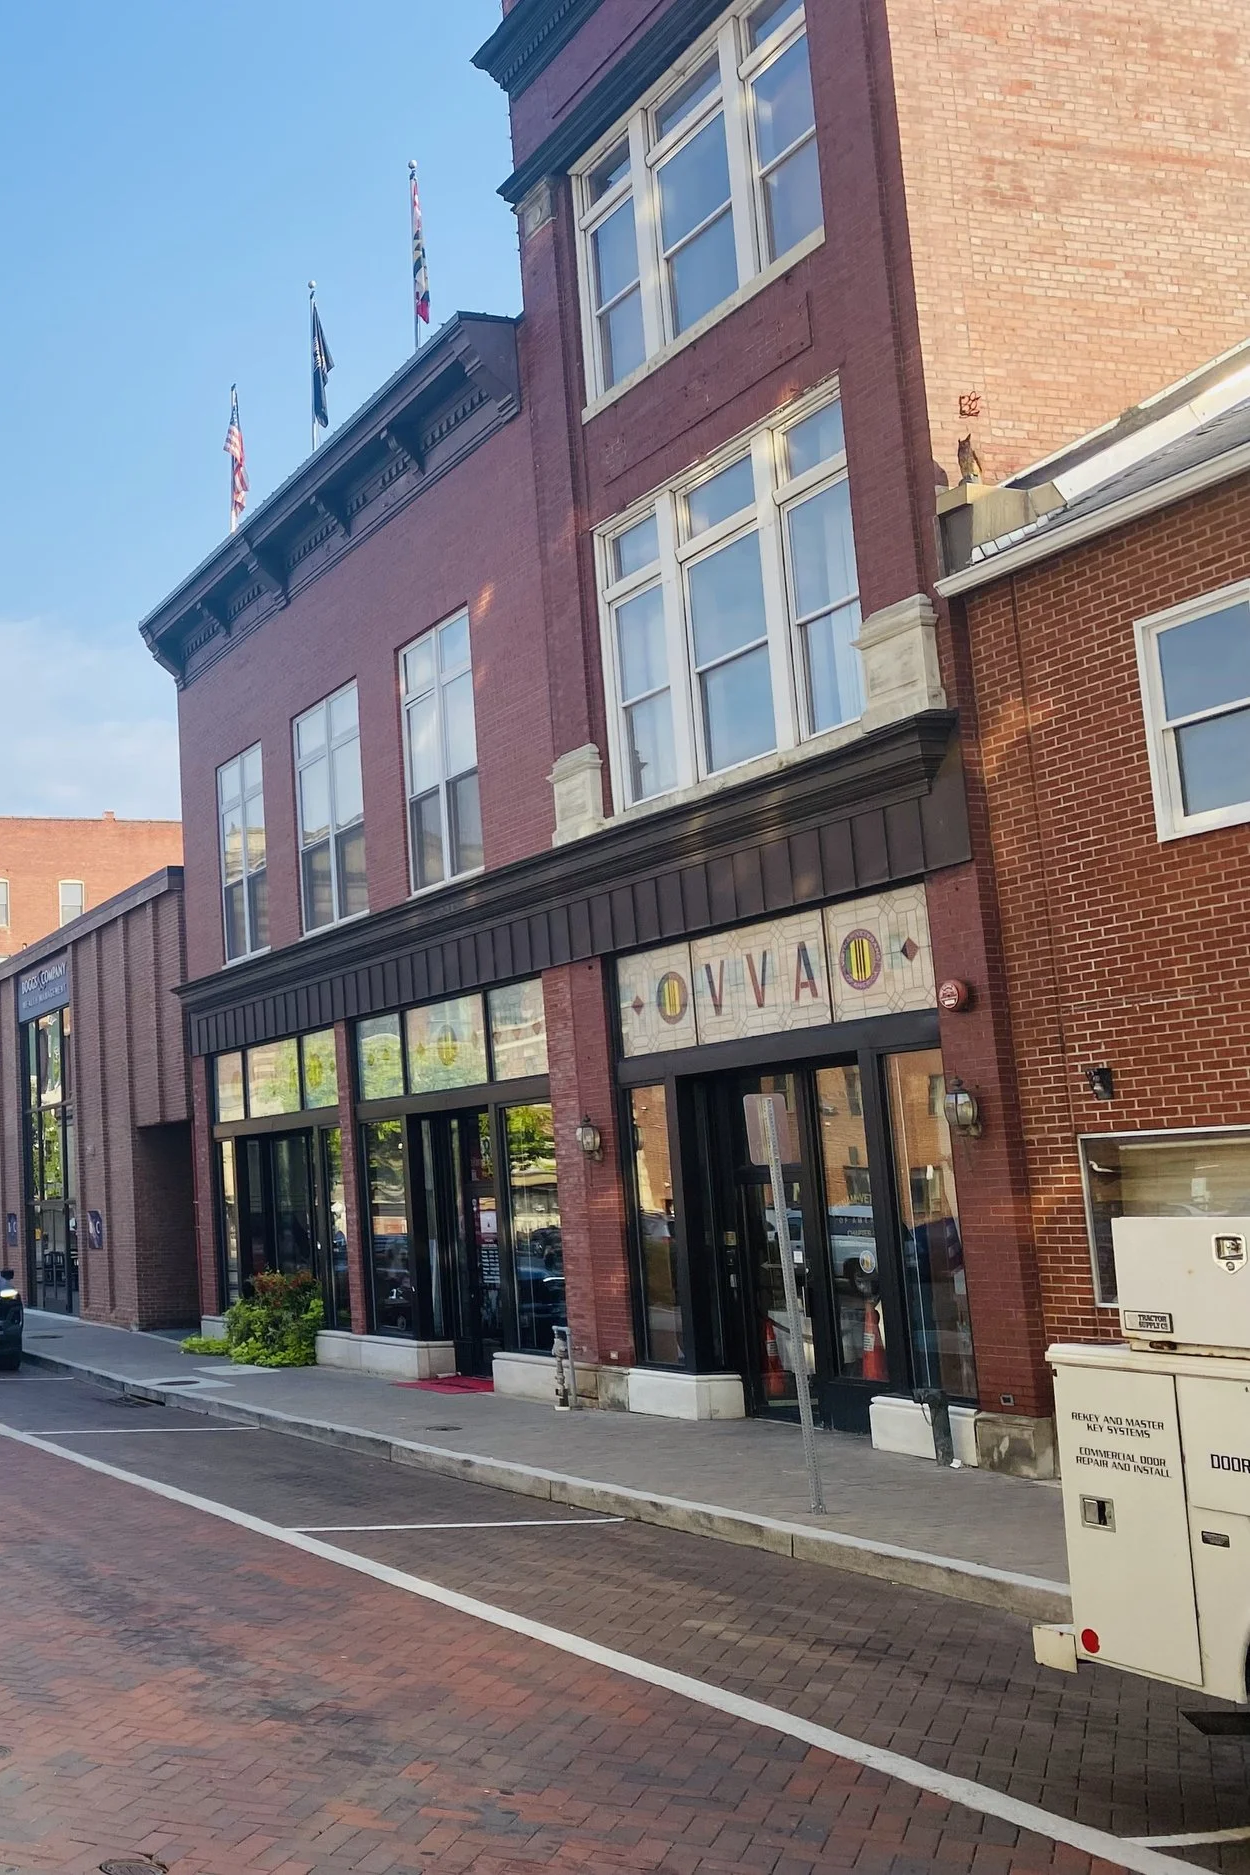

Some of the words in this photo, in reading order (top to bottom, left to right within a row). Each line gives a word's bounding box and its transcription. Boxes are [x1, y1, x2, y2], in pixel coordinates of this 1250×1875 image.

[41, 962, 67, 985] COMPANY
[705, 940, 819, 1017] VVA
[1138, 1314, 1167, 1323] TRACTOR
[1139, 1321, 1161, 1329] SUPPLY
[1071, 1411, 1100, 1423] REKEY
[1103, 1415, 1123, 1426] AND
[1125, 1418, 1165, 1431] MASTER
[1086, 1423, 1104, 1433] KEY
[1107, 1425, 1151, 1438] SYSTEMS
[1079, 1446, 1138, 1463] COMMERCIAL
[1140, 1455, 1167, 1467] DOOR
[1075, 1455, 1109, 1468] REPAIR
[1111, 1461, 1131, 1472] AND
[1133, 1464, 1172, 1479] INSTALL
